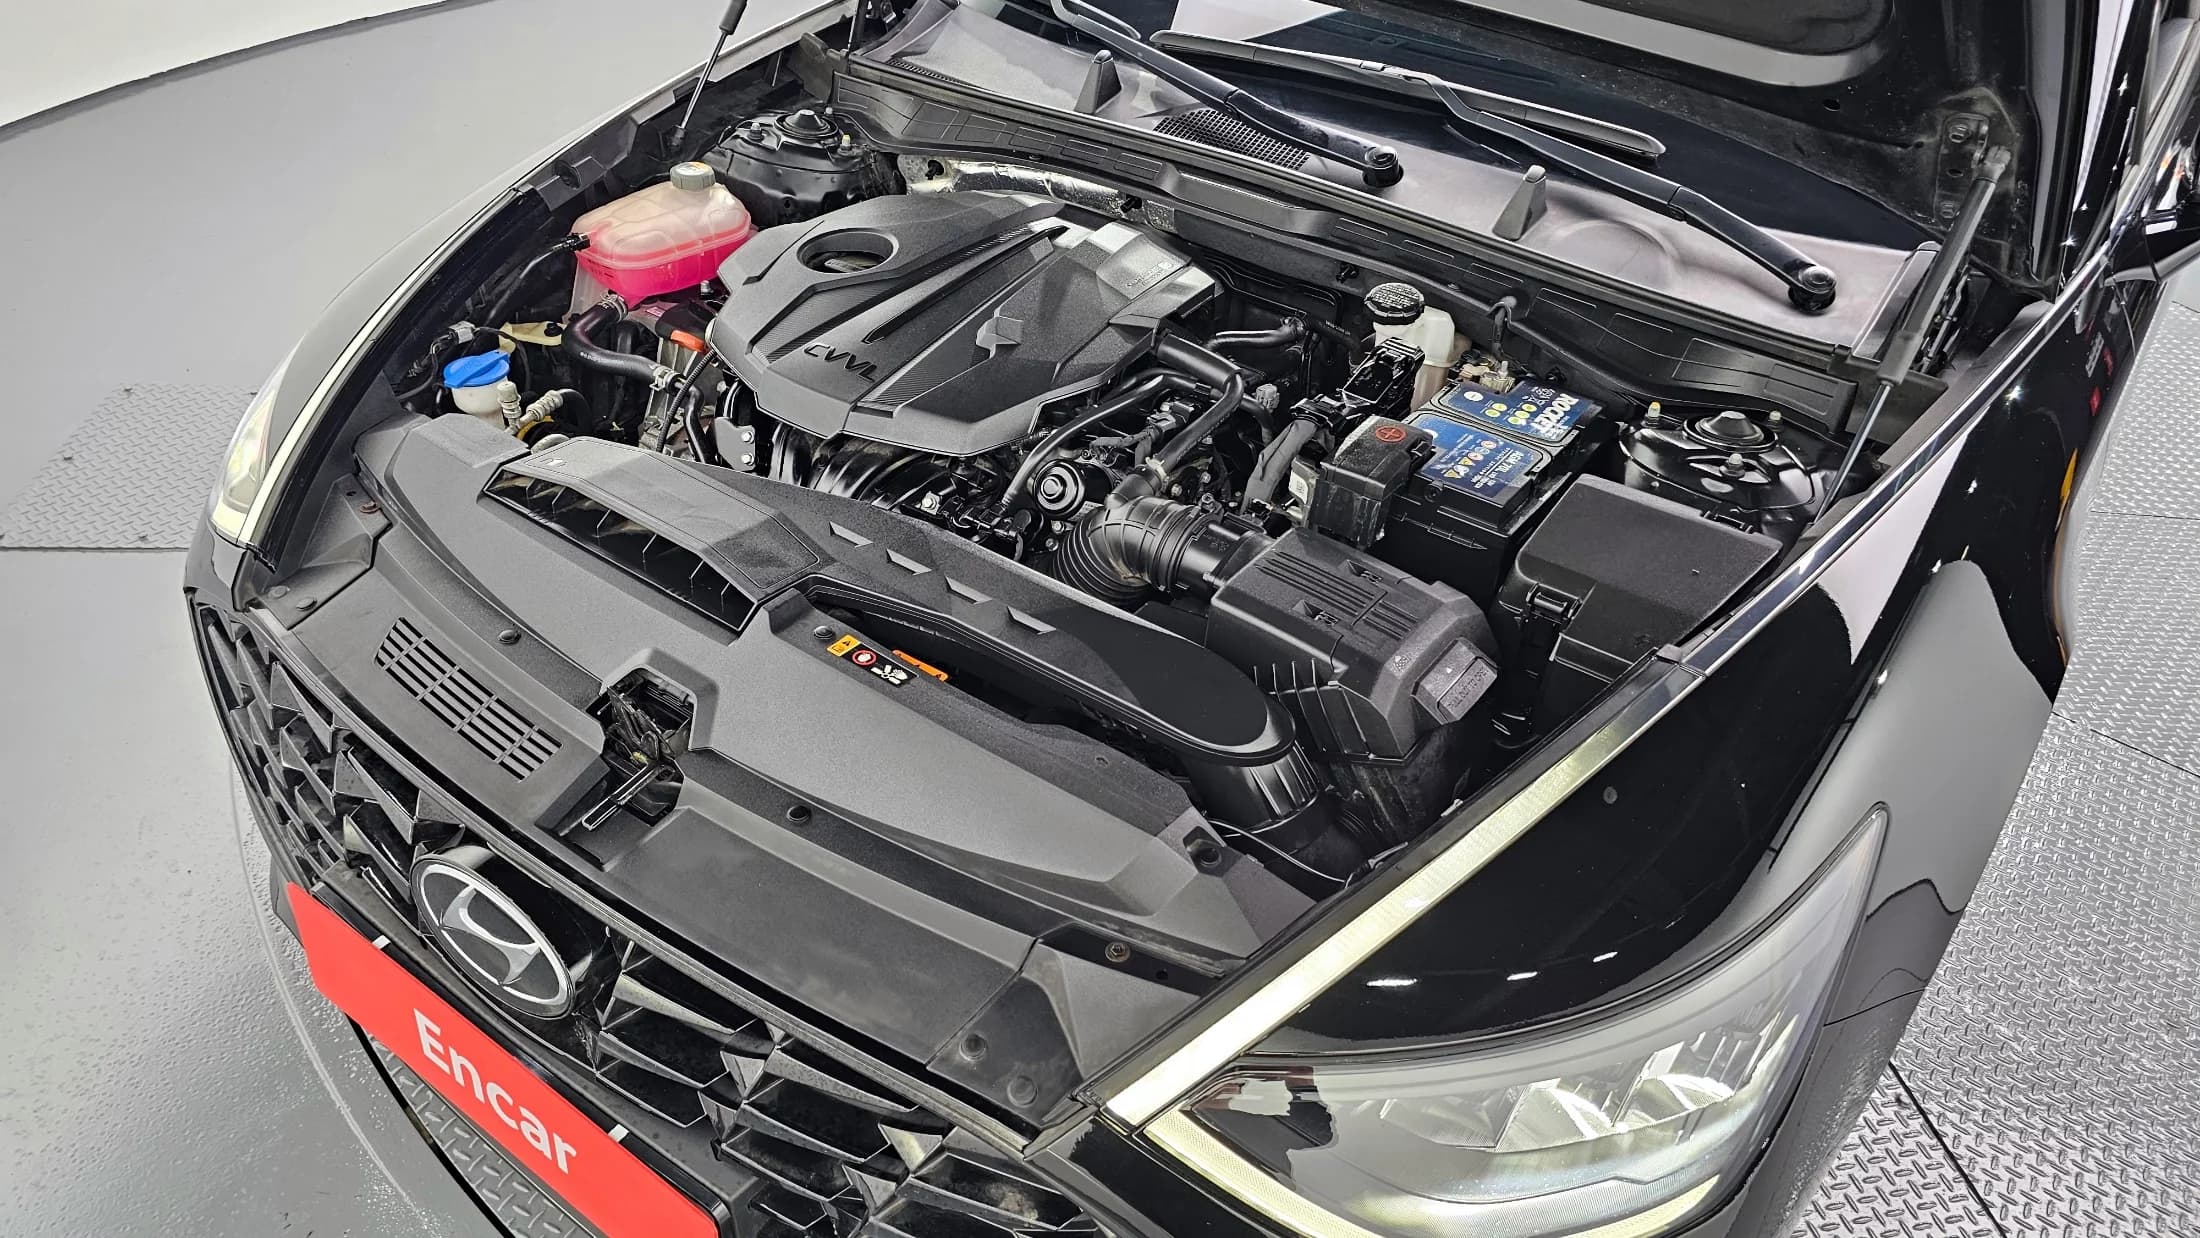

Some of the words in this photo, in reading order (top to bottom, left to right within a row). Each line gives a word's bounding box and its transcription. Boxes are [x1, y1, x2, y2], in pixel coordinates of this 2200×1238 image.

[803, 344, 877, 383] CVVL
[1530, 393, 1579, 433] ROCKET
[413, 1007, 577, 1175] Encar
